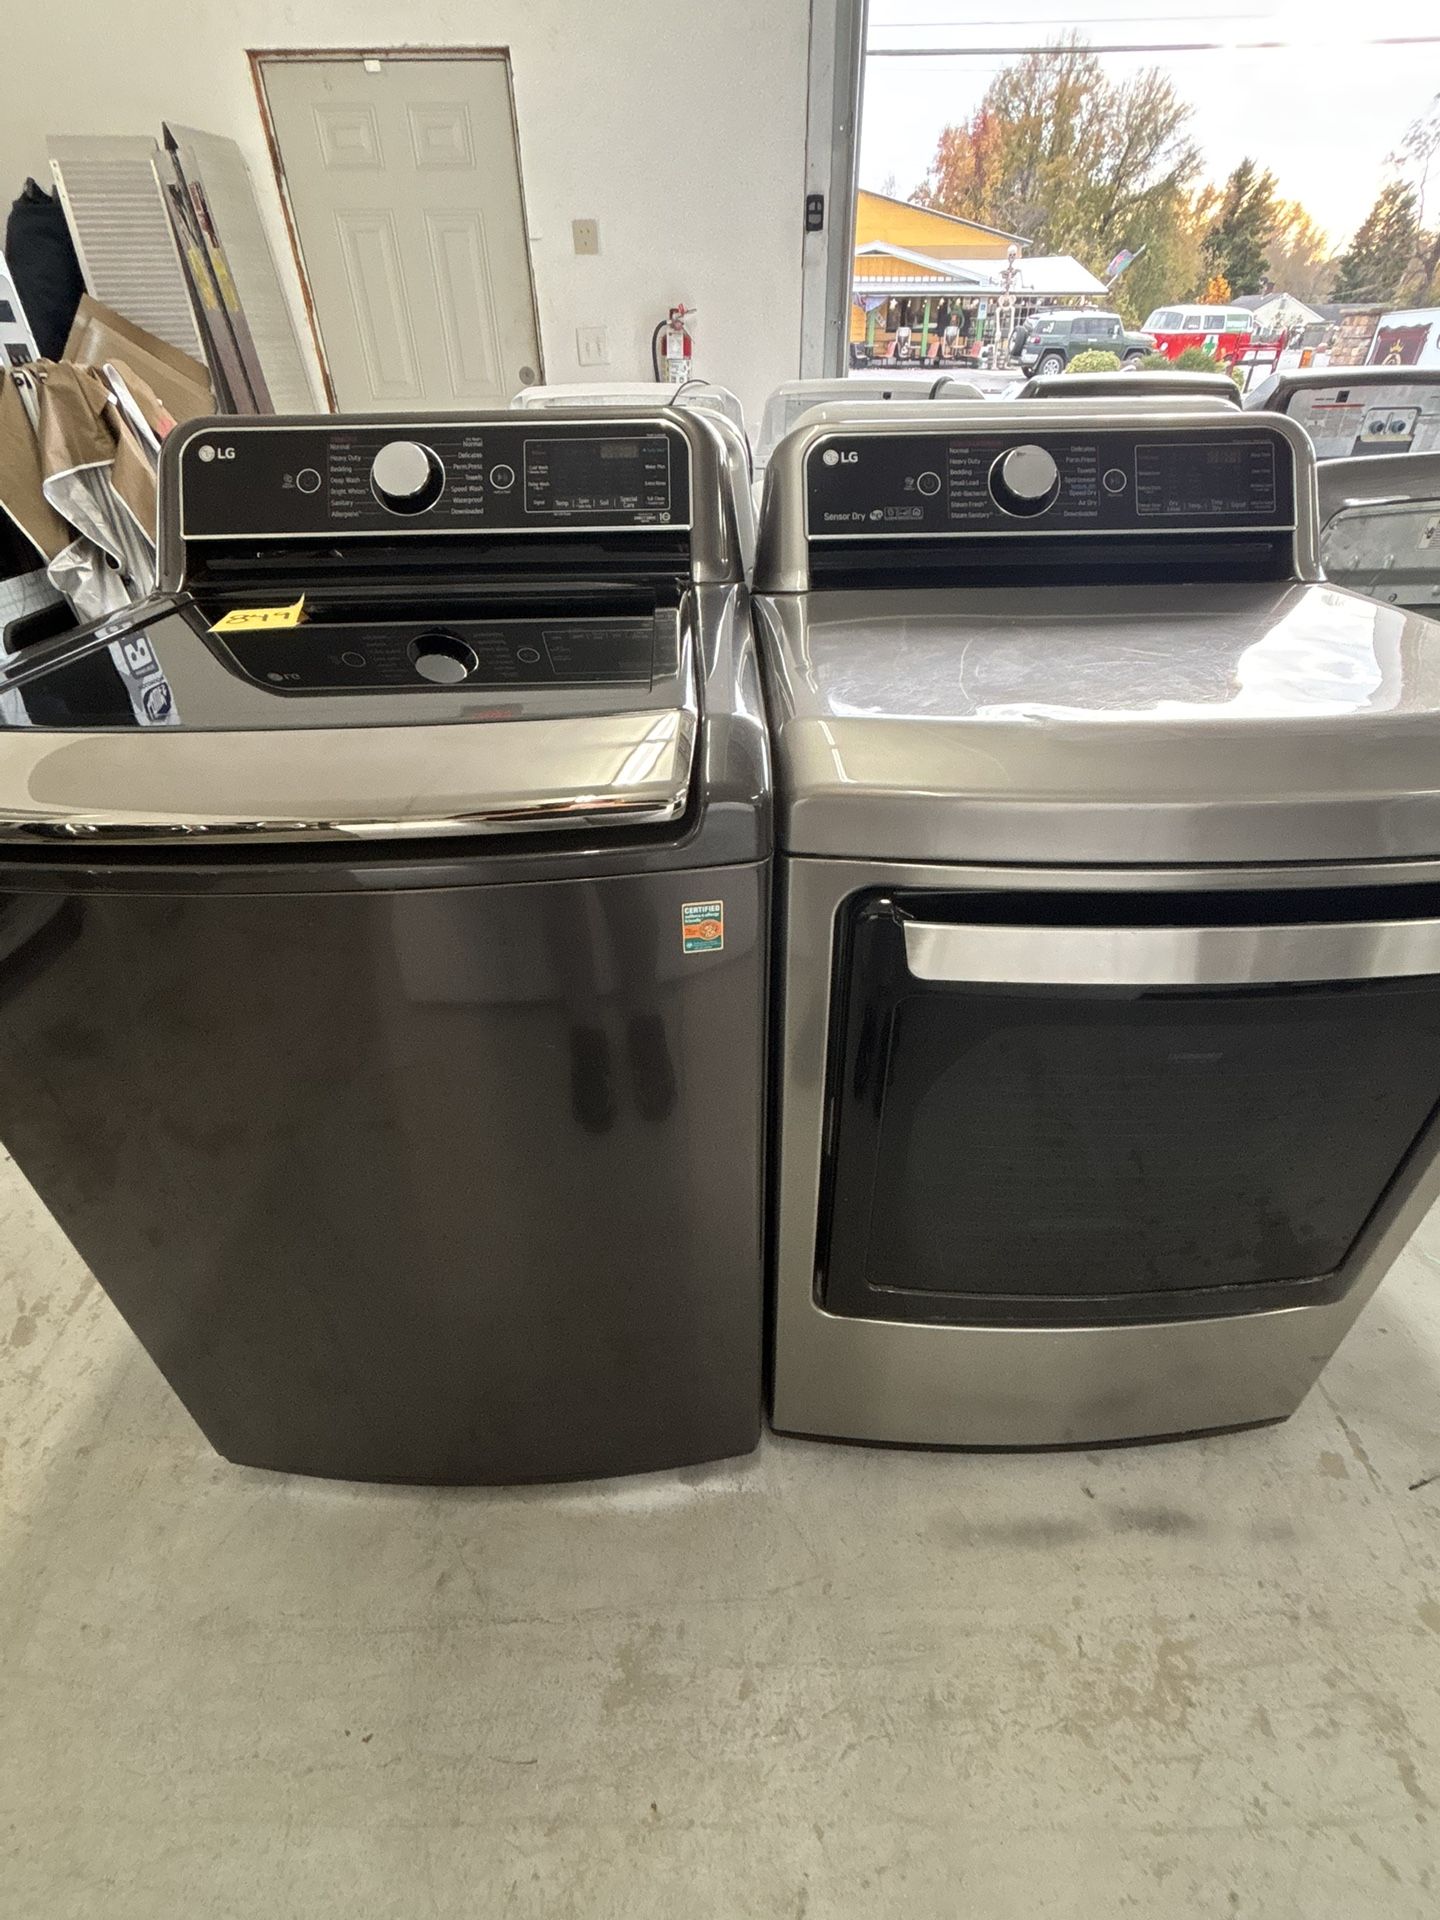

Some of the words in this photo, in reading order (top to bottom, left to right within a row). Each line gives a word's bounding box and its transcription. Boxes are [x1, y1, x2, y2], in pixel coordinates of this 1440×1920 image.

[217, 447, 236, 459] LG
[841, 451, 858, 463] LG
[823, 512, 850, 521] Sensor
[851, 512, 866, 522] Dry
[684, 905, 720, 914] CERTIFIED
